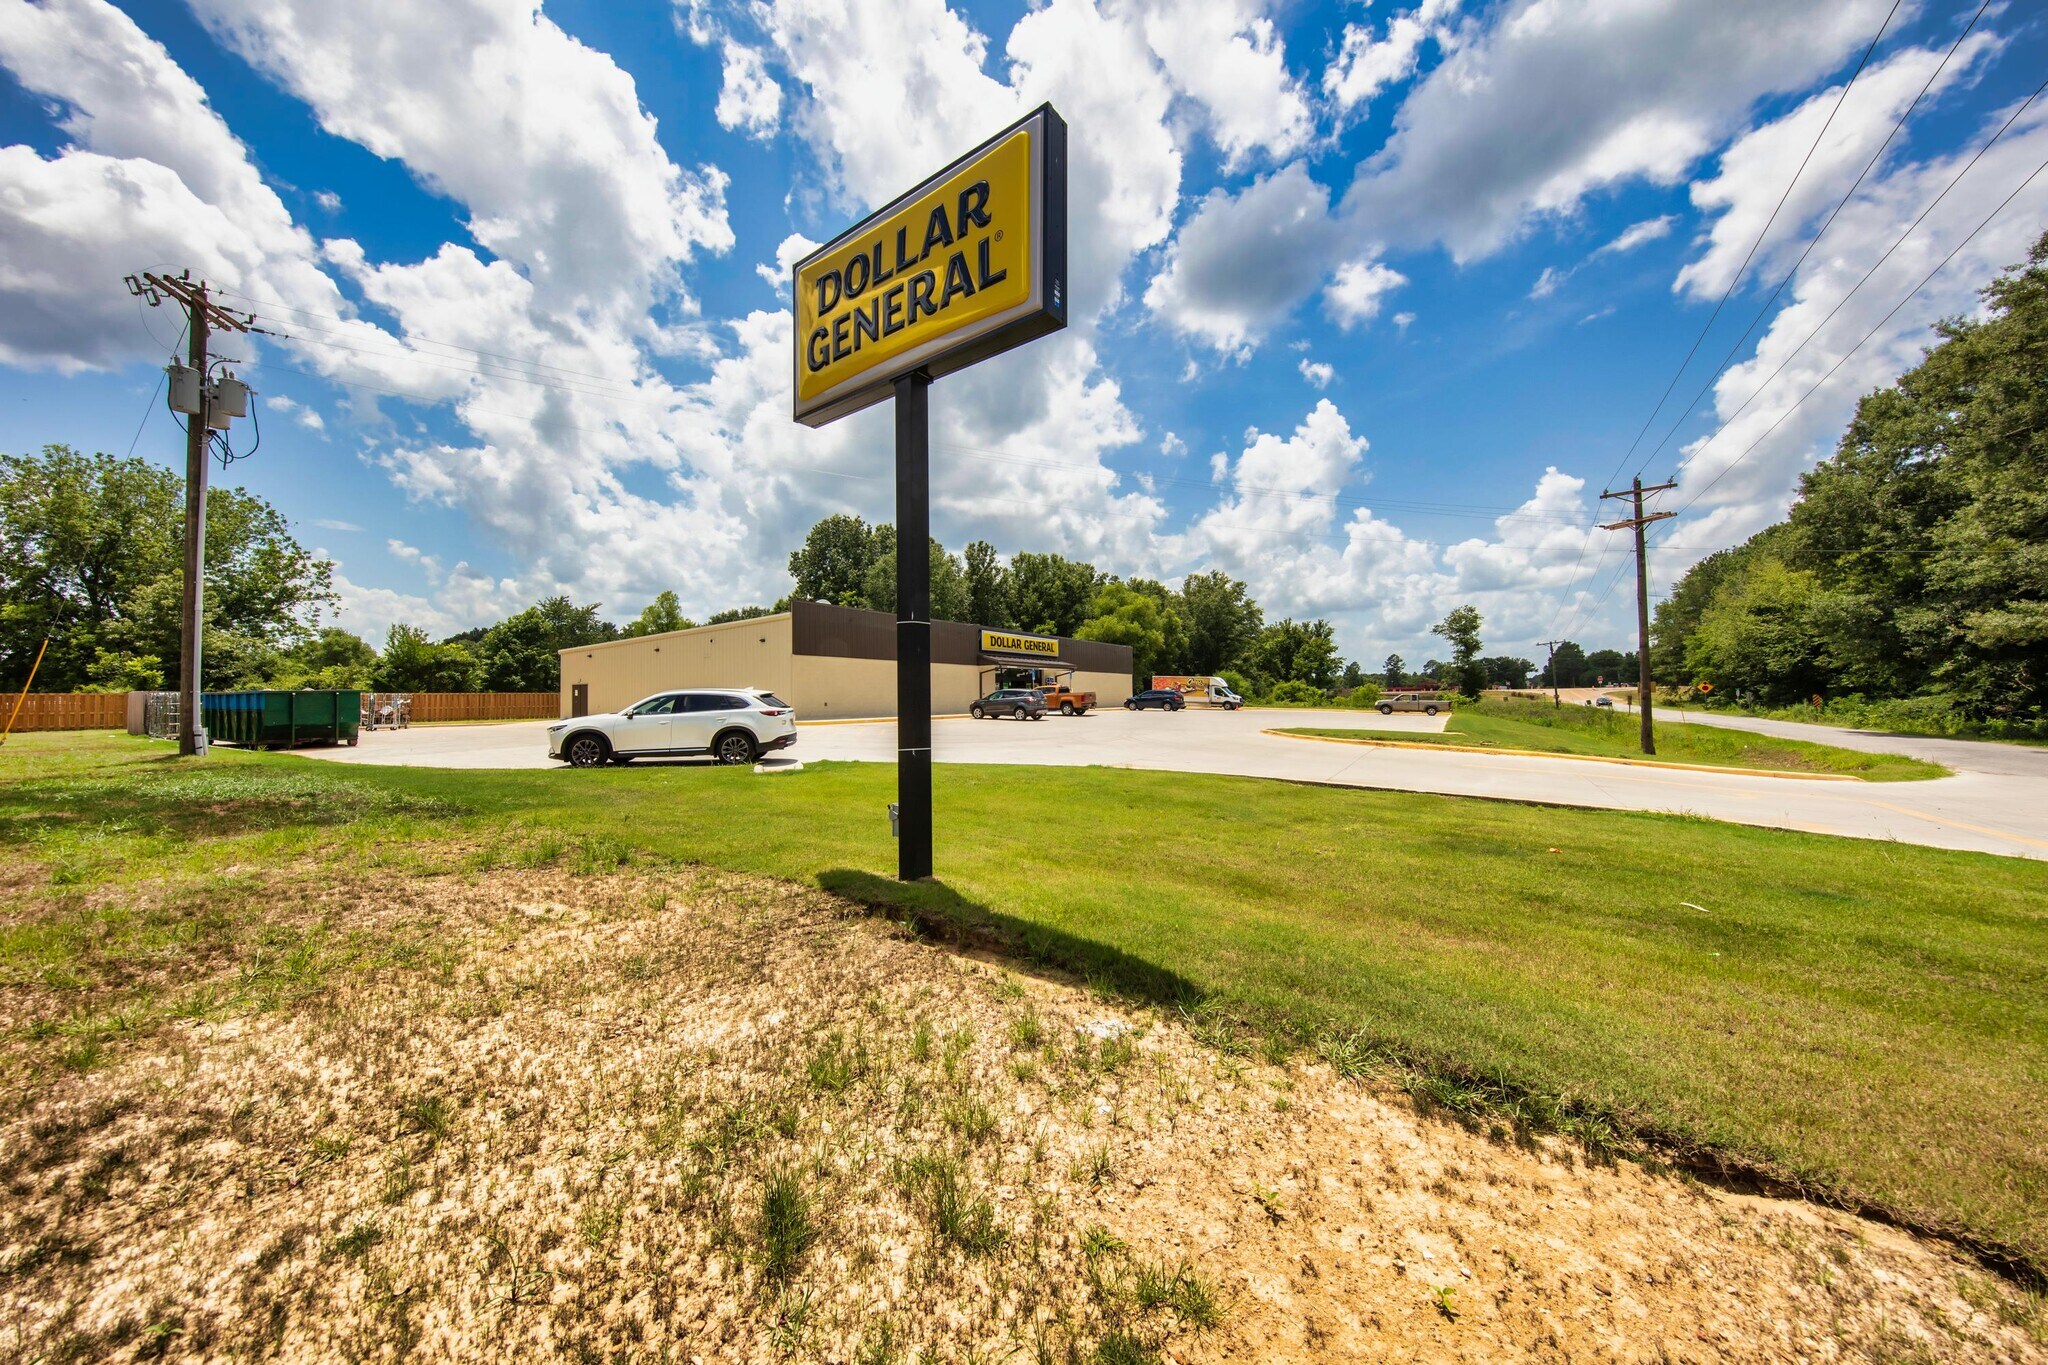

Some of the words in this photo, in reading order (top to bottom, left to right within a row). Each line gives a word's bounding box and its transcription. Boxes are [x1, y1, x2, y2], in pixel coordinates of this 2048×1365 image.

[807, 236, 1007, 372] GENERAL
[816, 180, 992, 317] DOLLAR
[990, 636, 1022, 649] DOLLAR
[1024, 640, 1055, 652] GENERAL
